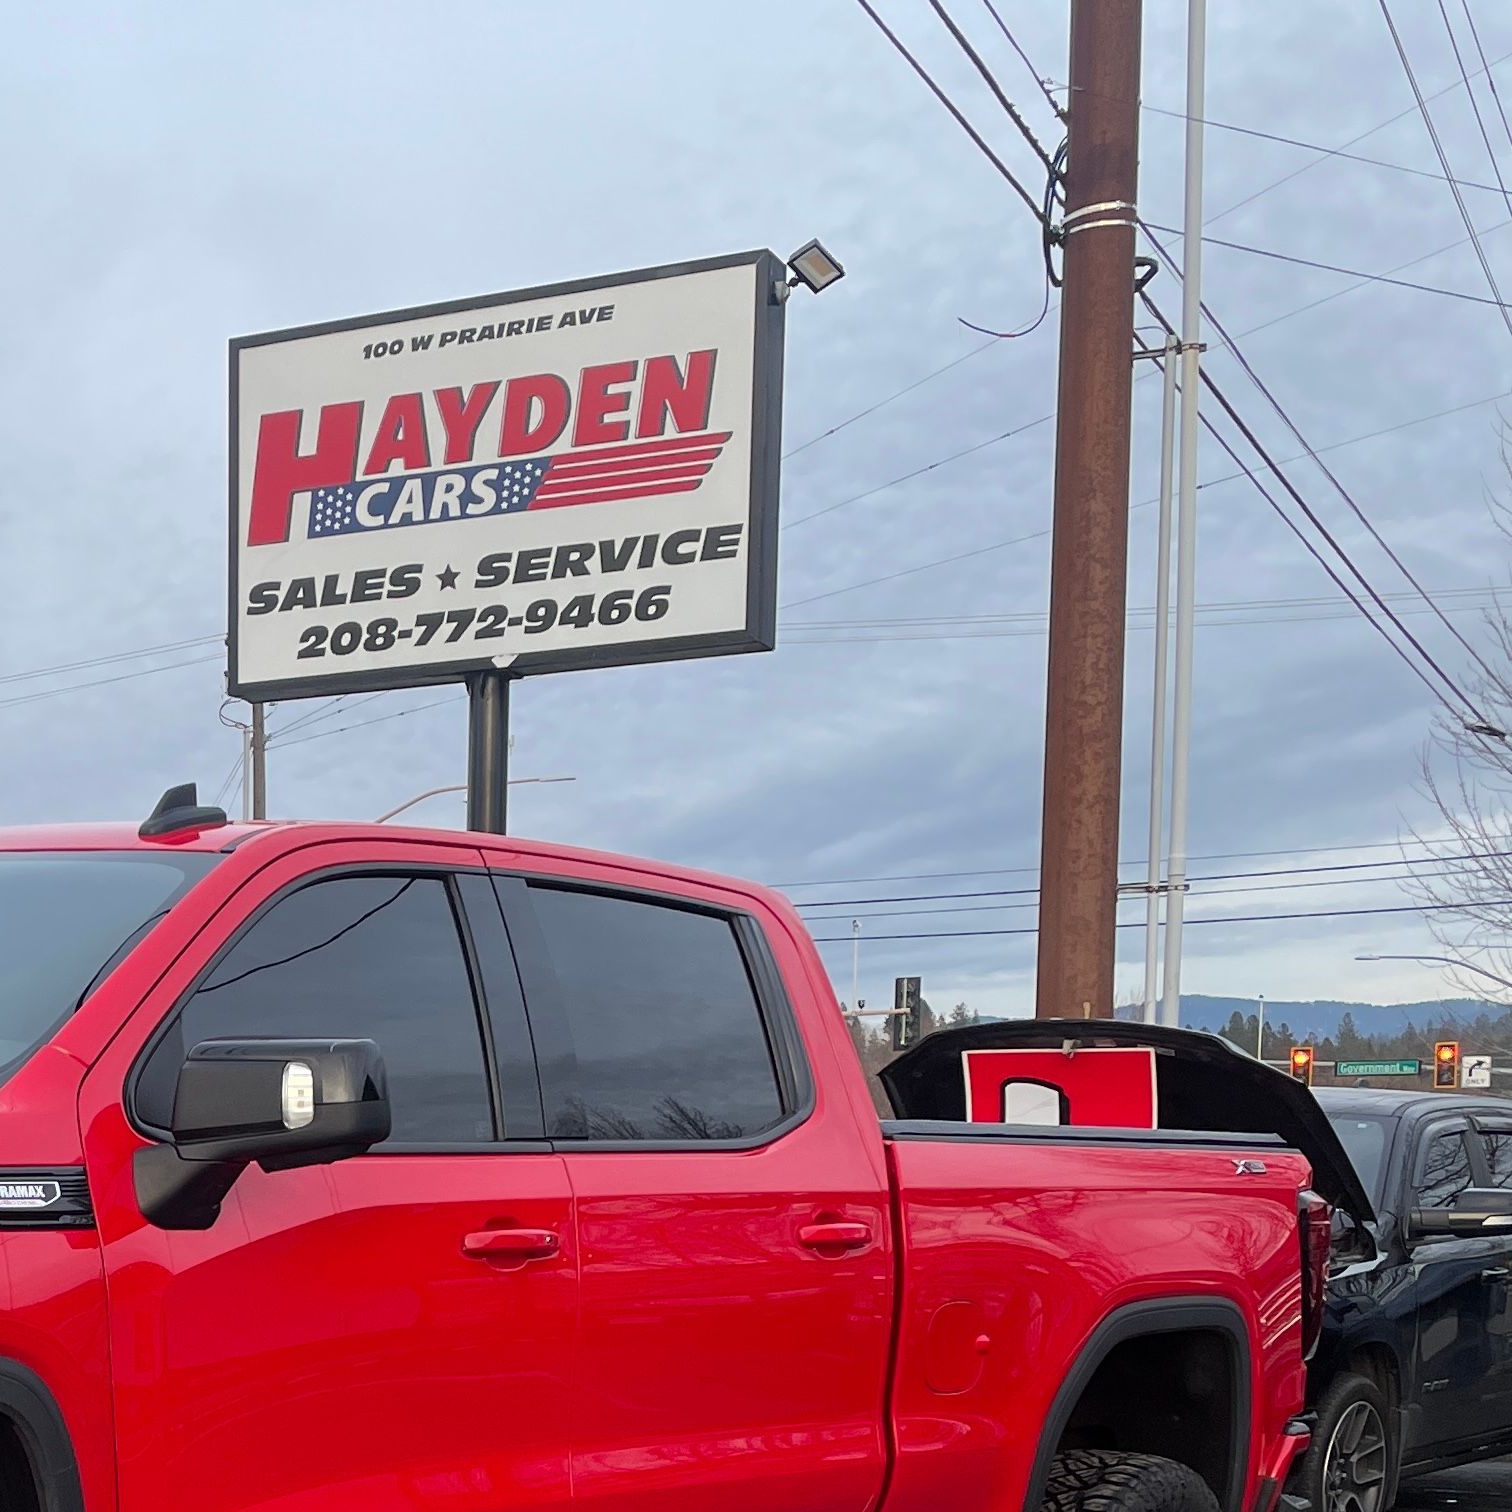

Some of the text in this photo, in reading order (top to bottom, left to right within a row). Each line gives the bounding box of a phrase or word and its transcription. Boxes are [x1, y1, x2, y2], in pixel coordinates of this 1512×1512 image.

[362, 304, 615, 360] 100 W PRAIRIE AVE
[246, 348, 719, 547] HAYDEN
[355, 468, 500, 528] CARS
[246, 522, 744, 616] SALES SERVICE
[296, 584, 673, 660] 208-772-9466
[1339, 1061, 1401, 1074] Government
